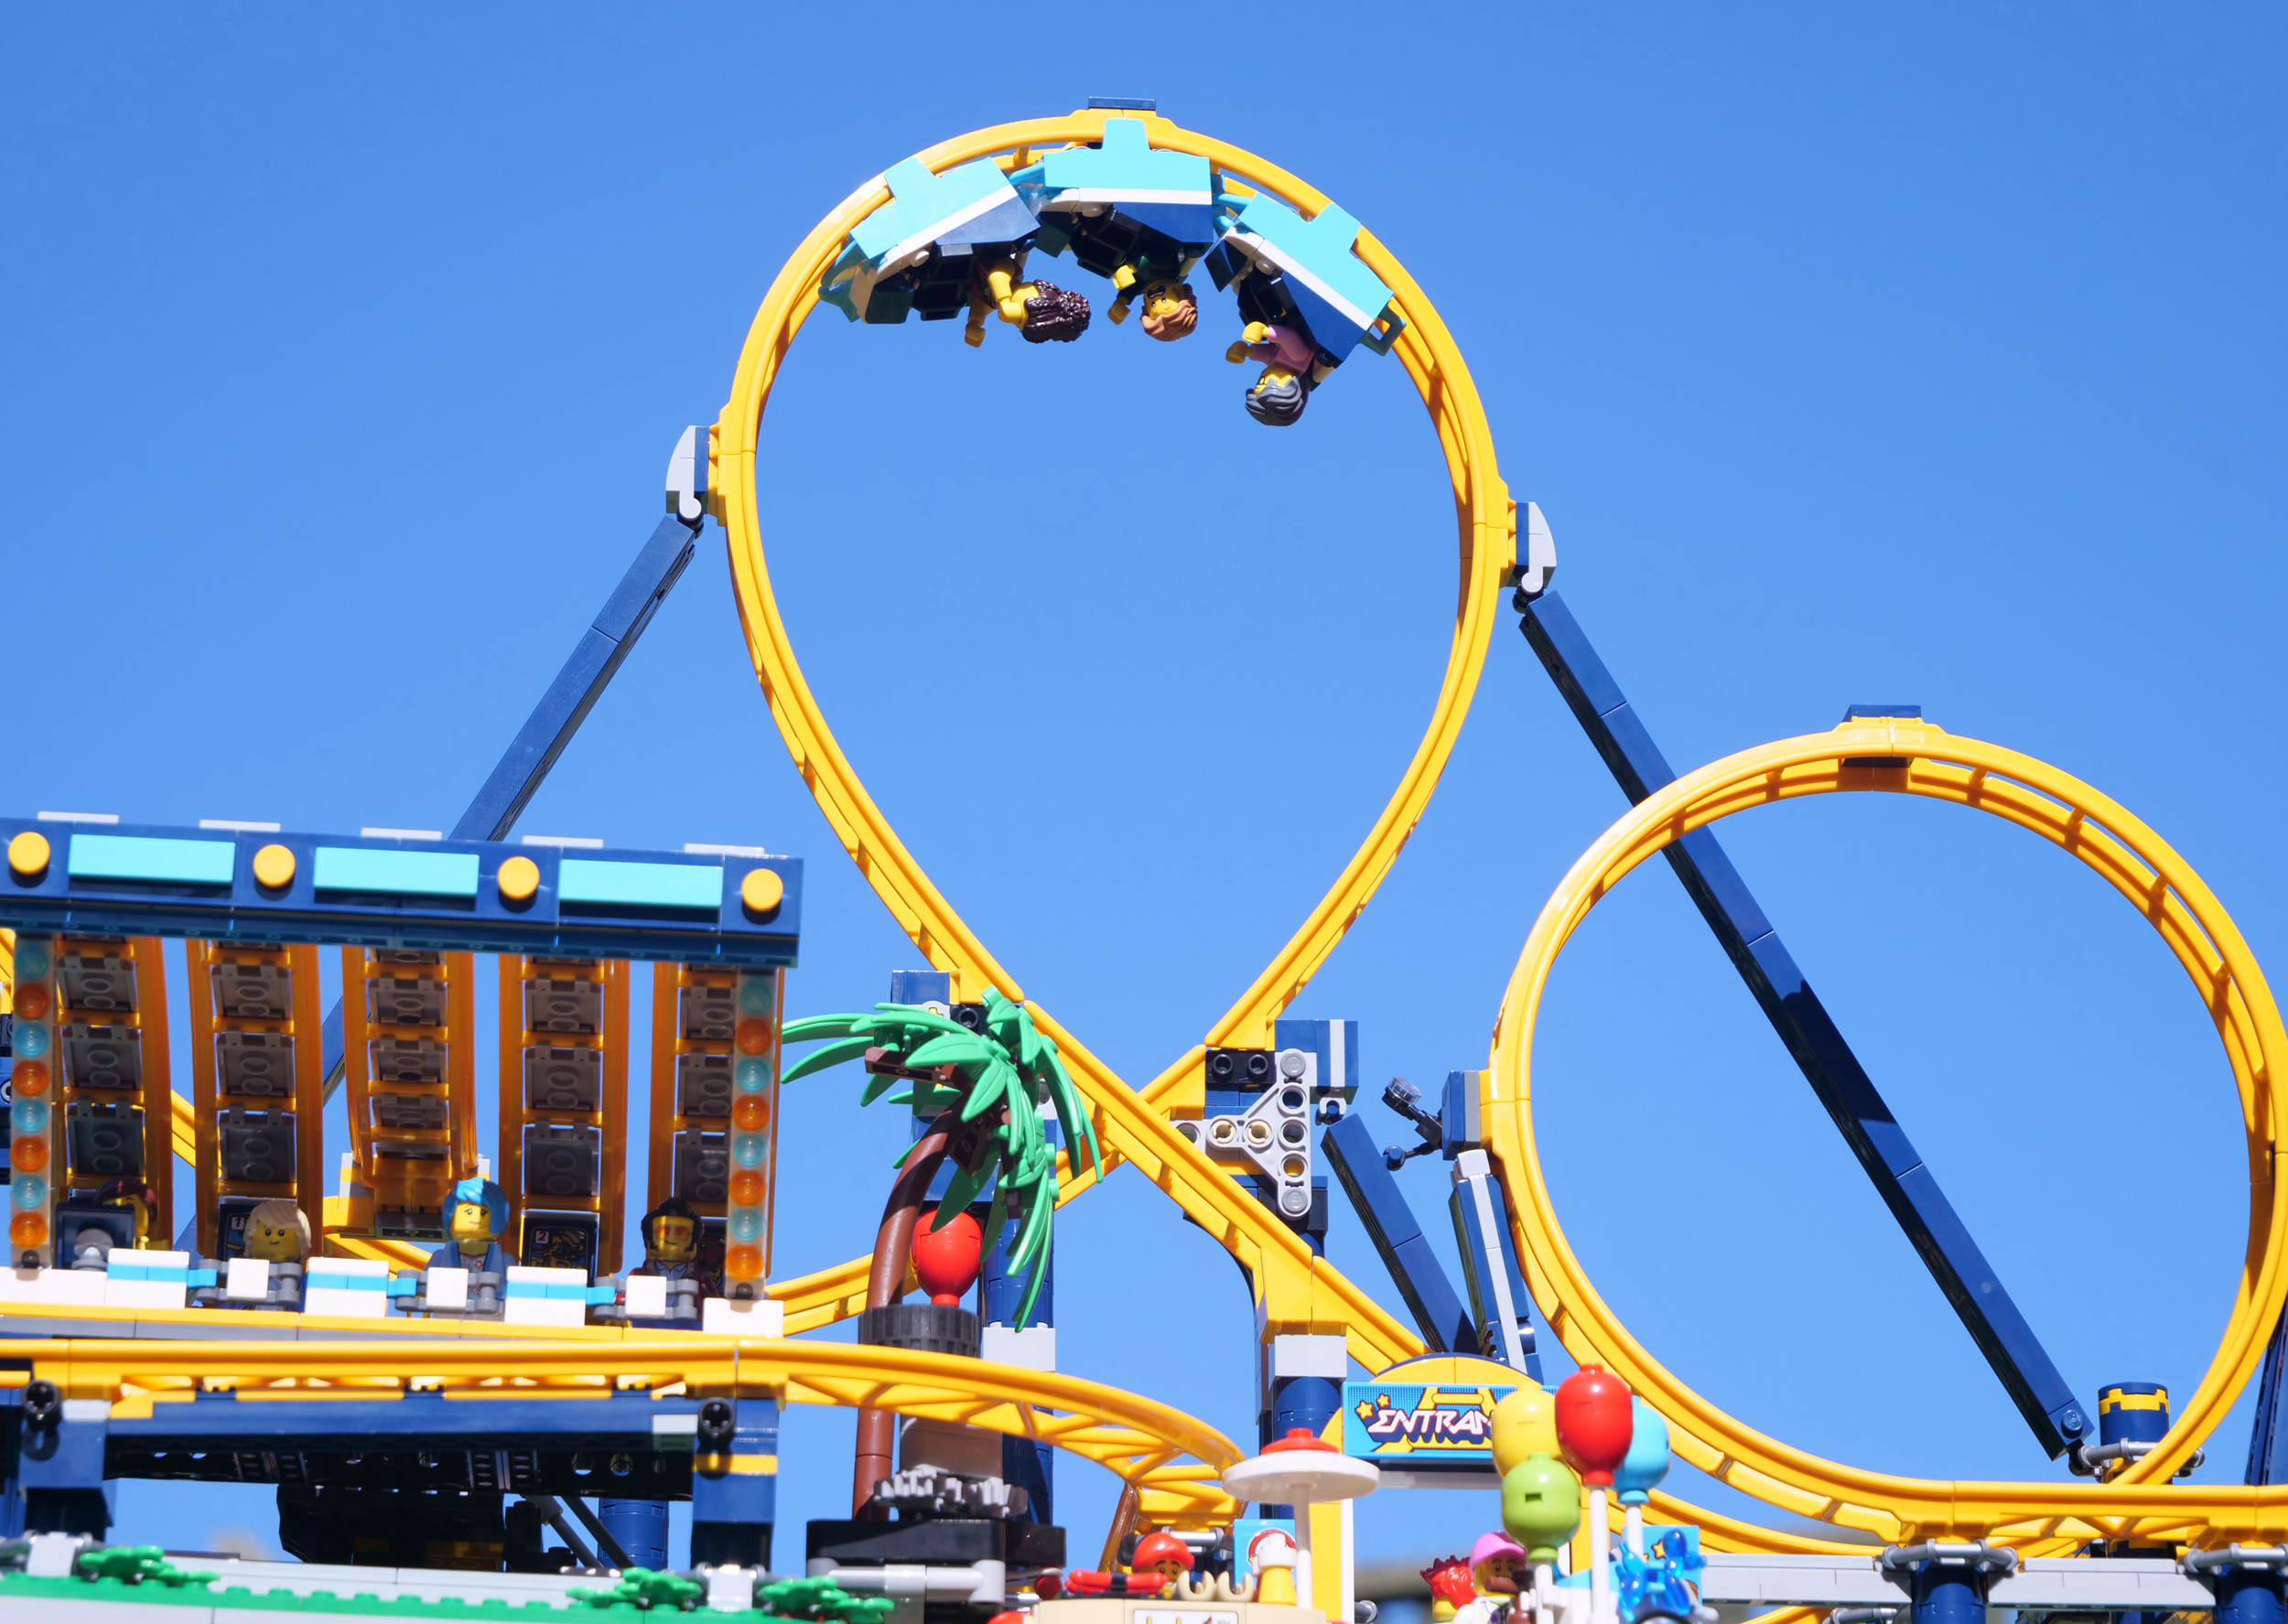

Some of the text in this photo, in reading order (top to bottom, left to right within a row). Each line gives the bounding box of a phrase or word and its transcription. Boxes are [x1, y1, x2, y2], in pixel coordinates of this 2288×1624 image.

[234, 1218, 242, 1228] 1
[537, 1231, 546, 1242] 2
[1367, 1409, 1493, 1435] ENTRAN
